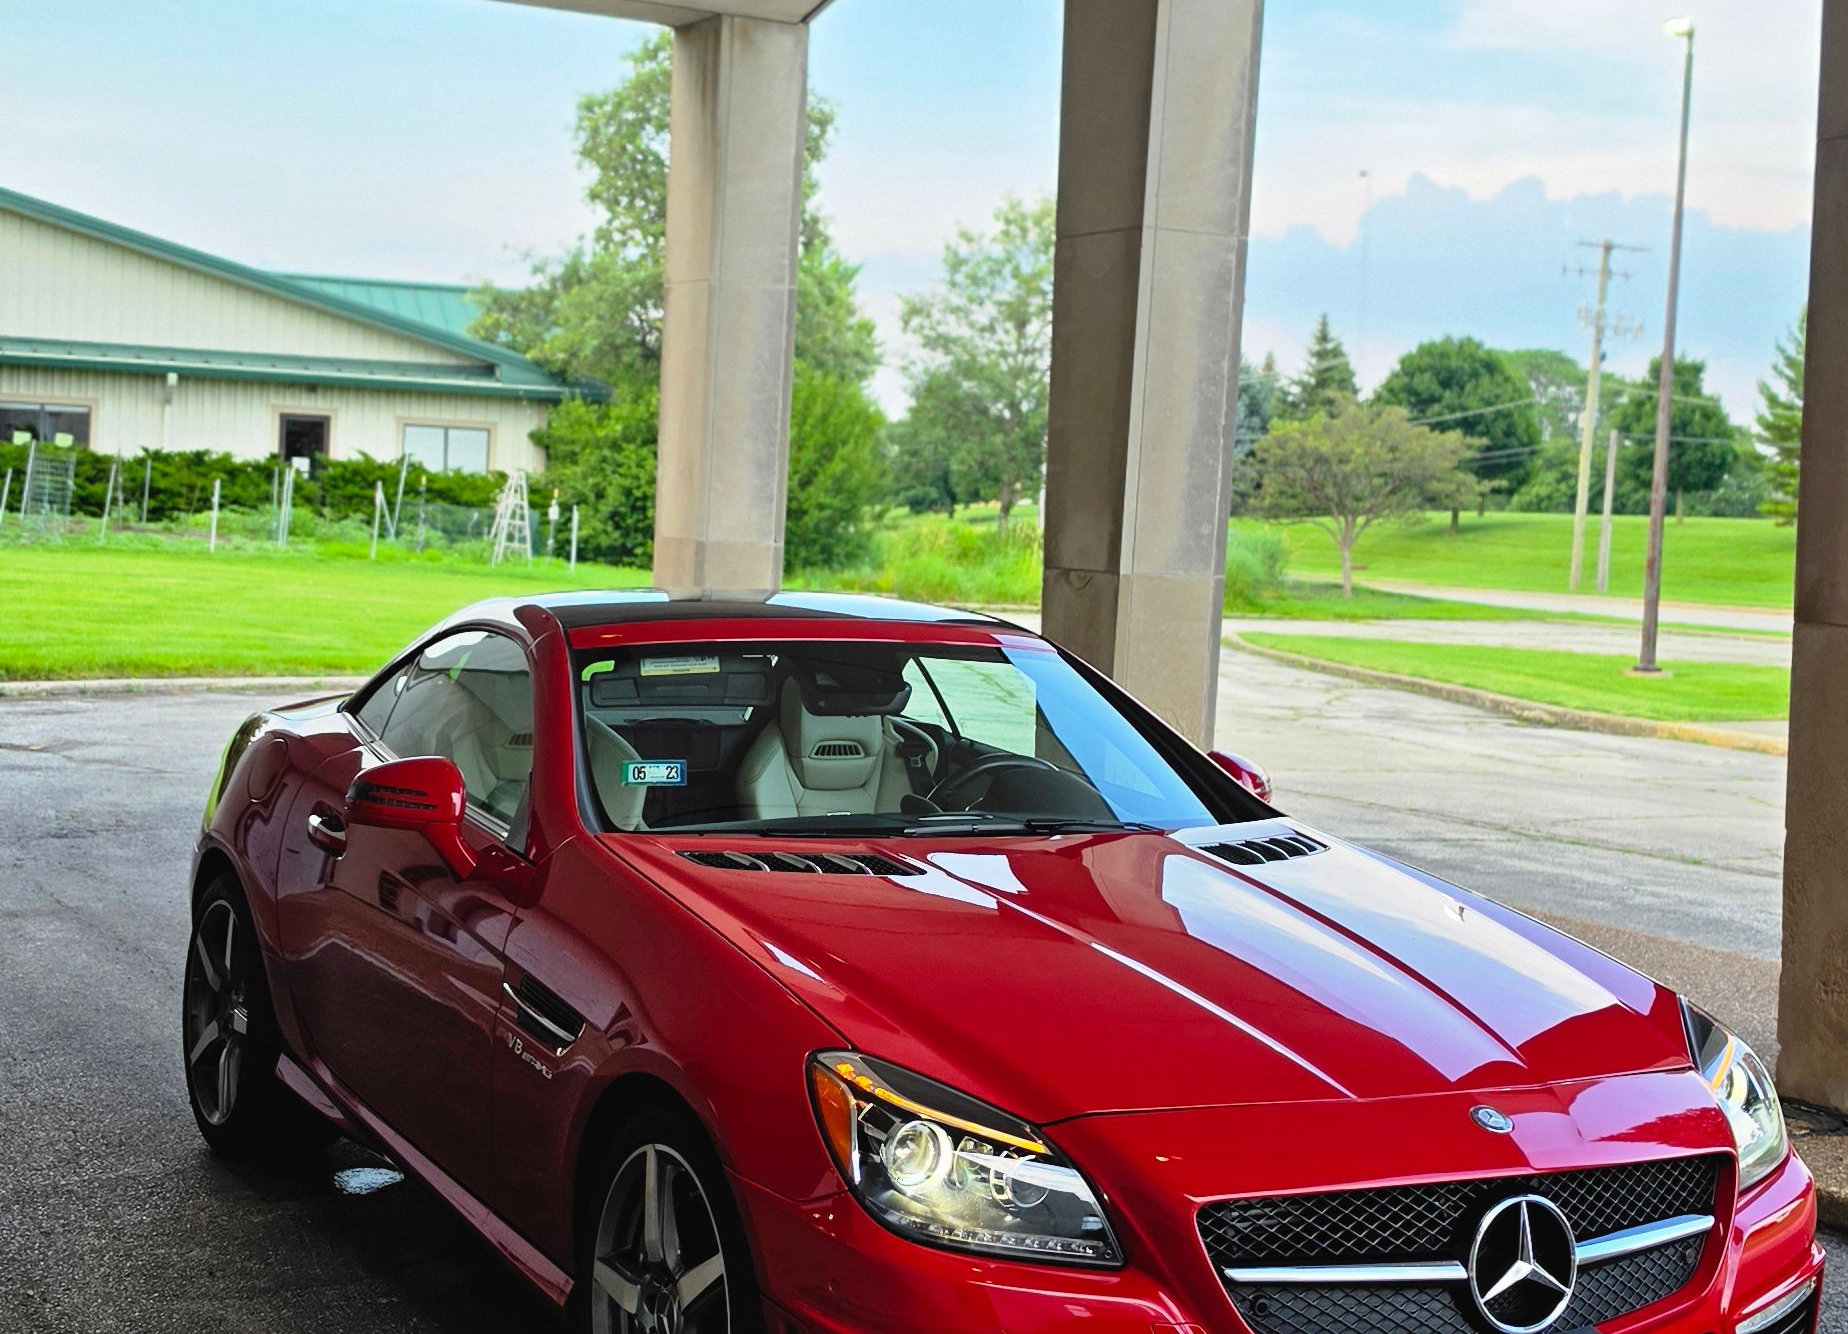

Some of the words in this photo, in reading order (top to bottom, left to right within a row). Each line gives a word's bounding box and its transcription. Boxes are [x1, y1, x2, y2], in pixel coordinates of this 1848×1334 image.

[633, 766, 646, 780] 05
[666, 765, 679, 779] 23
[507, 1033, 523, 1054] V8
